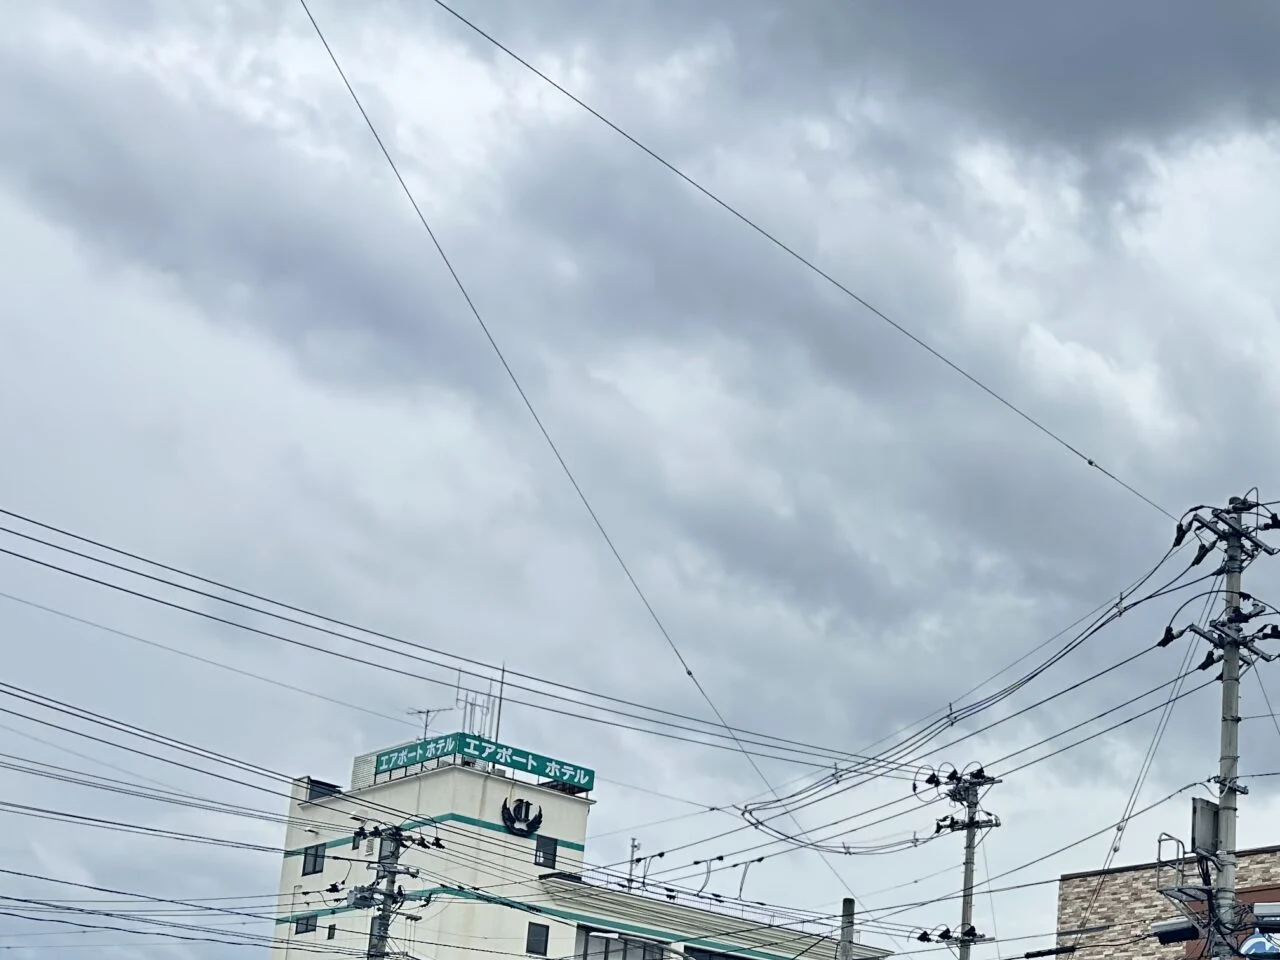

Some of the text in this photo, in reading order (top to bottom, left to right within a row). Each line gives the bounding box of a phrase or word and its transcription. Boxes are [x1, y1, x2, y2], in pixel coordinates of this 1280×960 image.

[379, 737, 456, 771] エアポート ホテル
[463, 738, 590, 785] エアポート ホテル
